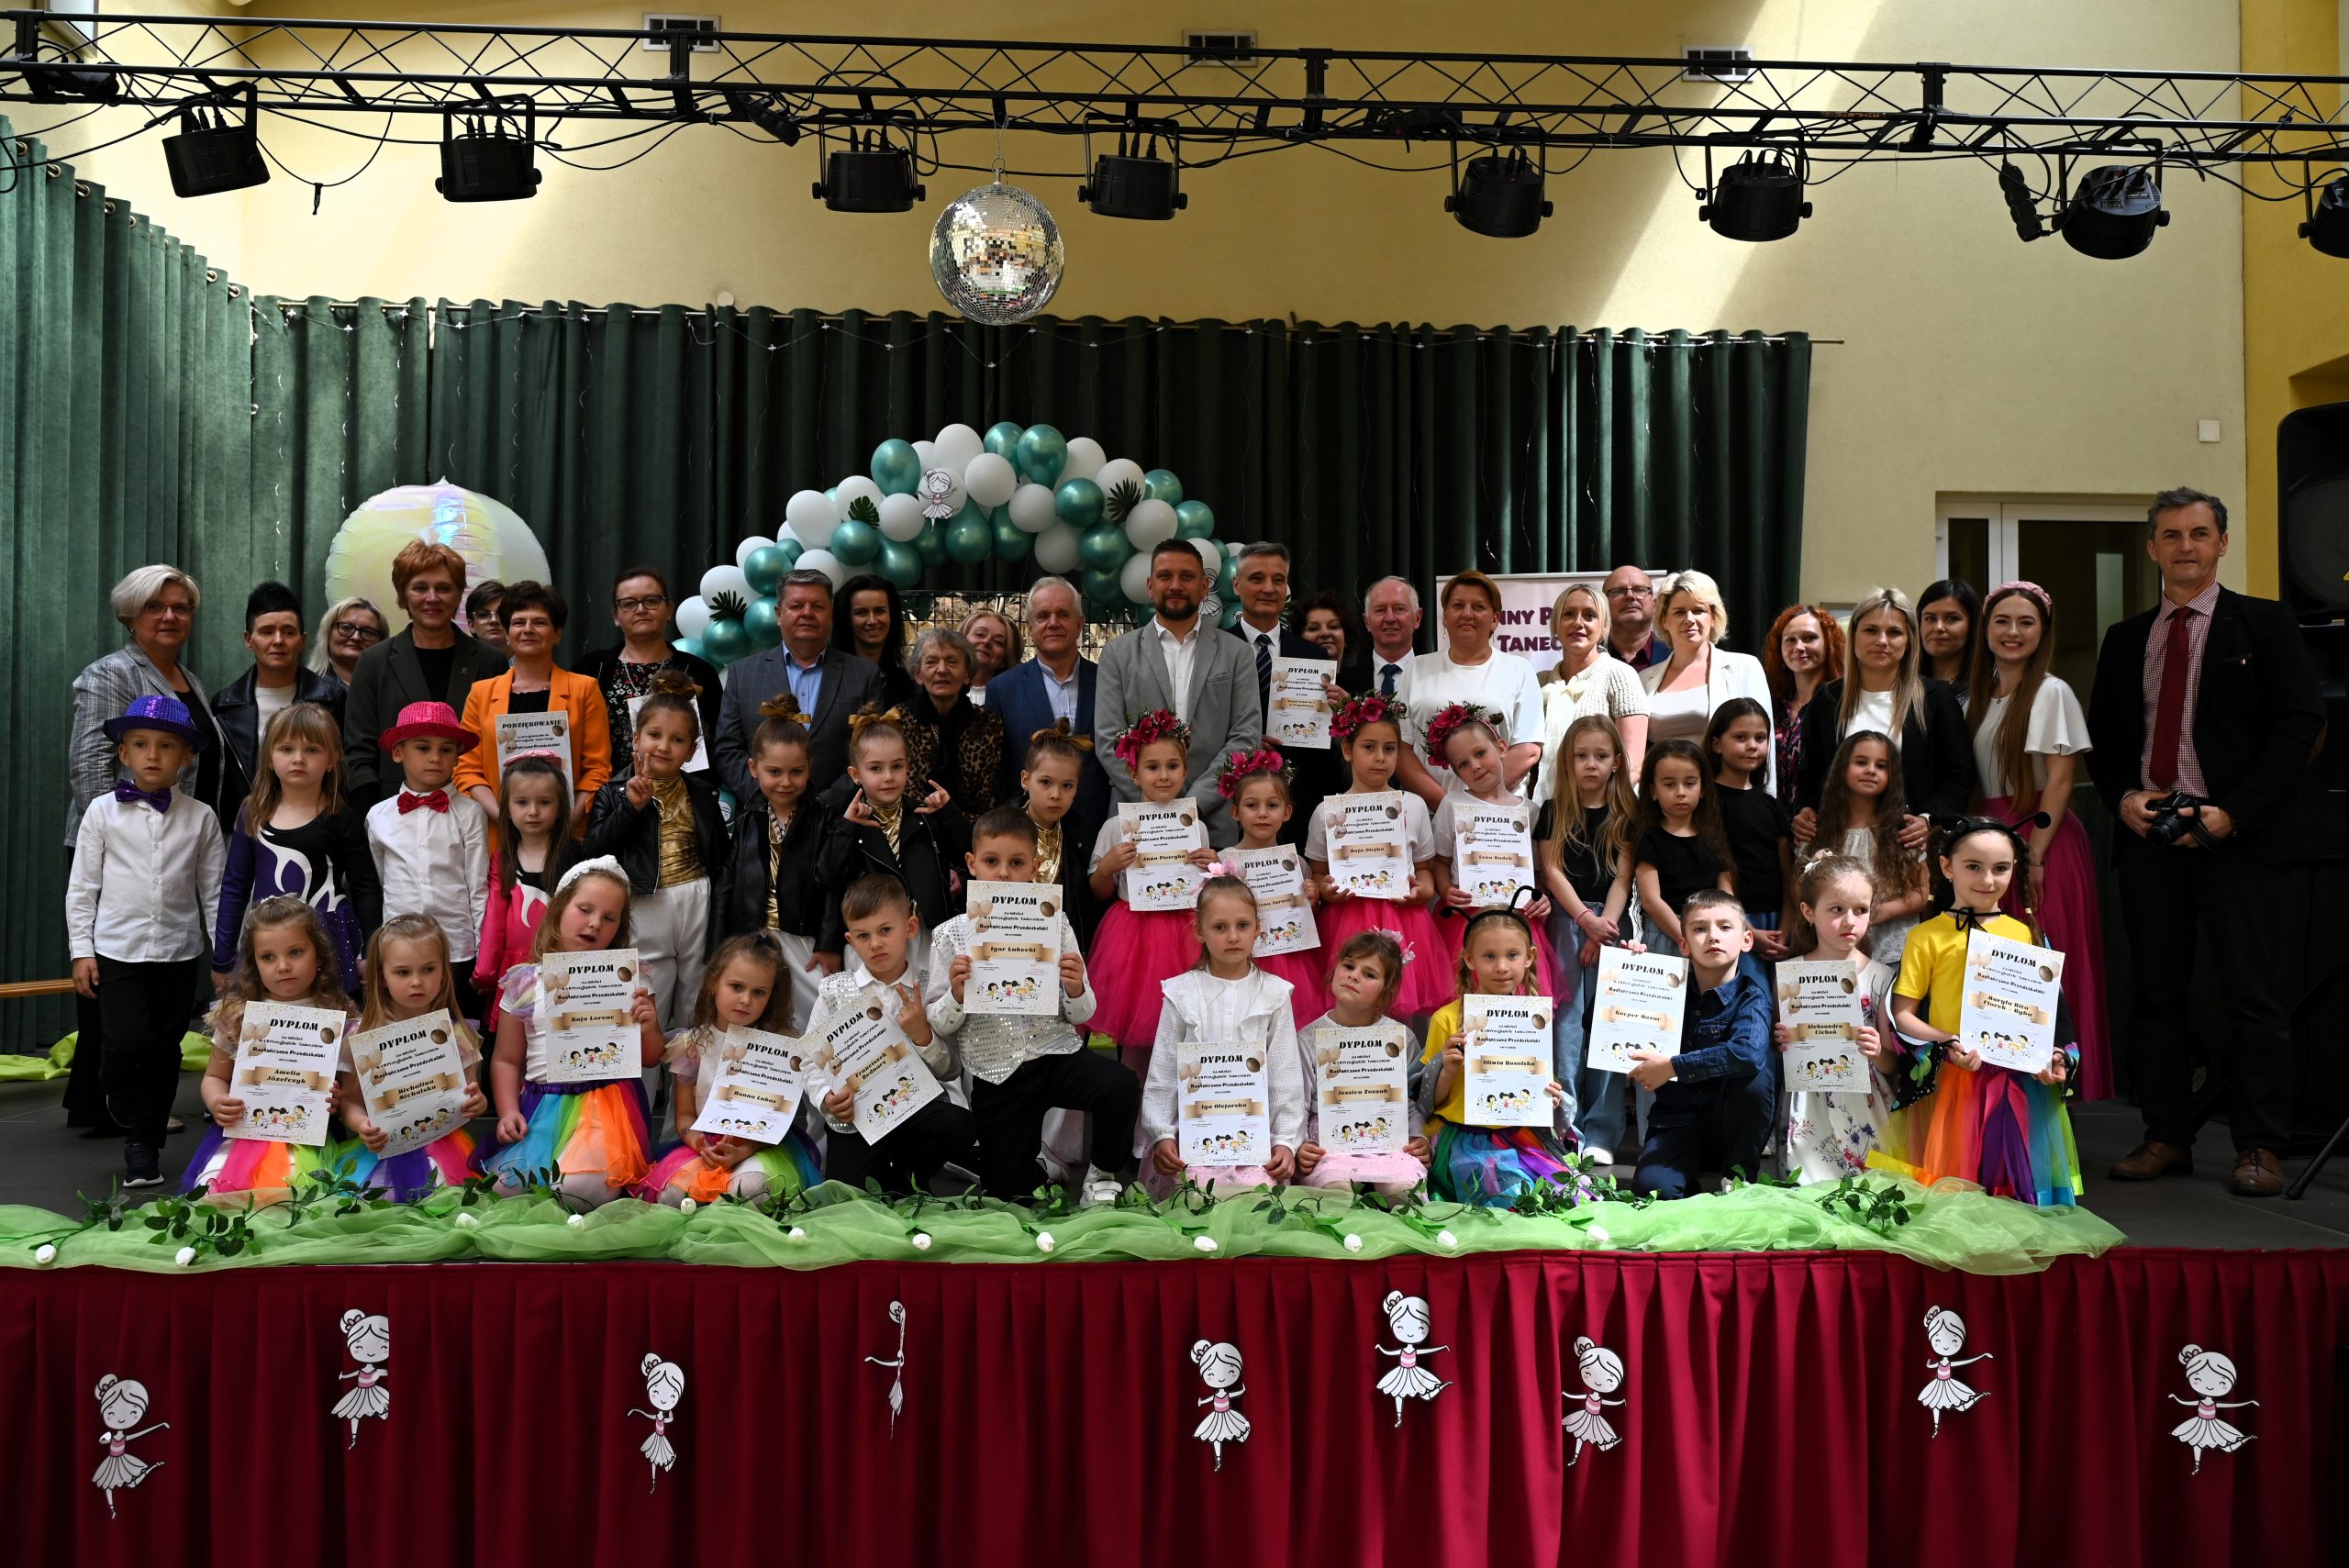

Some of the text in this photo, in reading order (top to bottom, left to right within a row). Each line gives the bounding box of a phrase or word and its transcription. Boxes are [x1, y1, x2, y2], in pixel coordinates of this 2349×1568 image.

[502, 719, 562, 729] PODZIĘKOWANIE
[1345, 805, 1383, 814] DYPLOM
[1139, 811, 1177, 821] DYPLOM
[1474, 816, 1510, 824] DYPLOM
[1244, 858, 1279, 869] DYPLOM
[991, 895, 1038, 905] DYPLOM
[1991, 949, 2037, 968] DYPLOM
[568, 964, 614, 974] DYPLOM
[1621, 962, 1664, 975] DYPLOM
[1798, 975, 1838, 984] DYPLOM
[2013, 1002, 2029, 1010] Rita
[1486, 1009, 1529, 1018] DYPLOM
[1615, 1010, 1662, 1022] Kacper Mazur
[2013, 1008, 2032, 1018] Ryba
[269, 1018, 318, 1031] DYPLOM
[826, 1011, 864, 1043] DYPLOM
[379, 1029, 427, 1051] DYPLOM
[1339, 1040, 1382, 1049] DYPLOM
[289, 1050, 326, 1058] Przedszkolaki
[746, 1042, 789, 1058] DYPLOM
[409, 1053, 446, 1069] Przedszkolaki
[1200, 1055, 1243, 1064] DYPLOM
[854, 1052, 887, 1078] Franciszek
[862, 1060, 887, 1080] Bednarz
[266, 1075, 306, 1084] Józefczyk
[397, 1079, 434, 1095] Michalina
[398, 1085, 437, 1101] Michalska
[733, 1090, 756, 1099] Hanna
